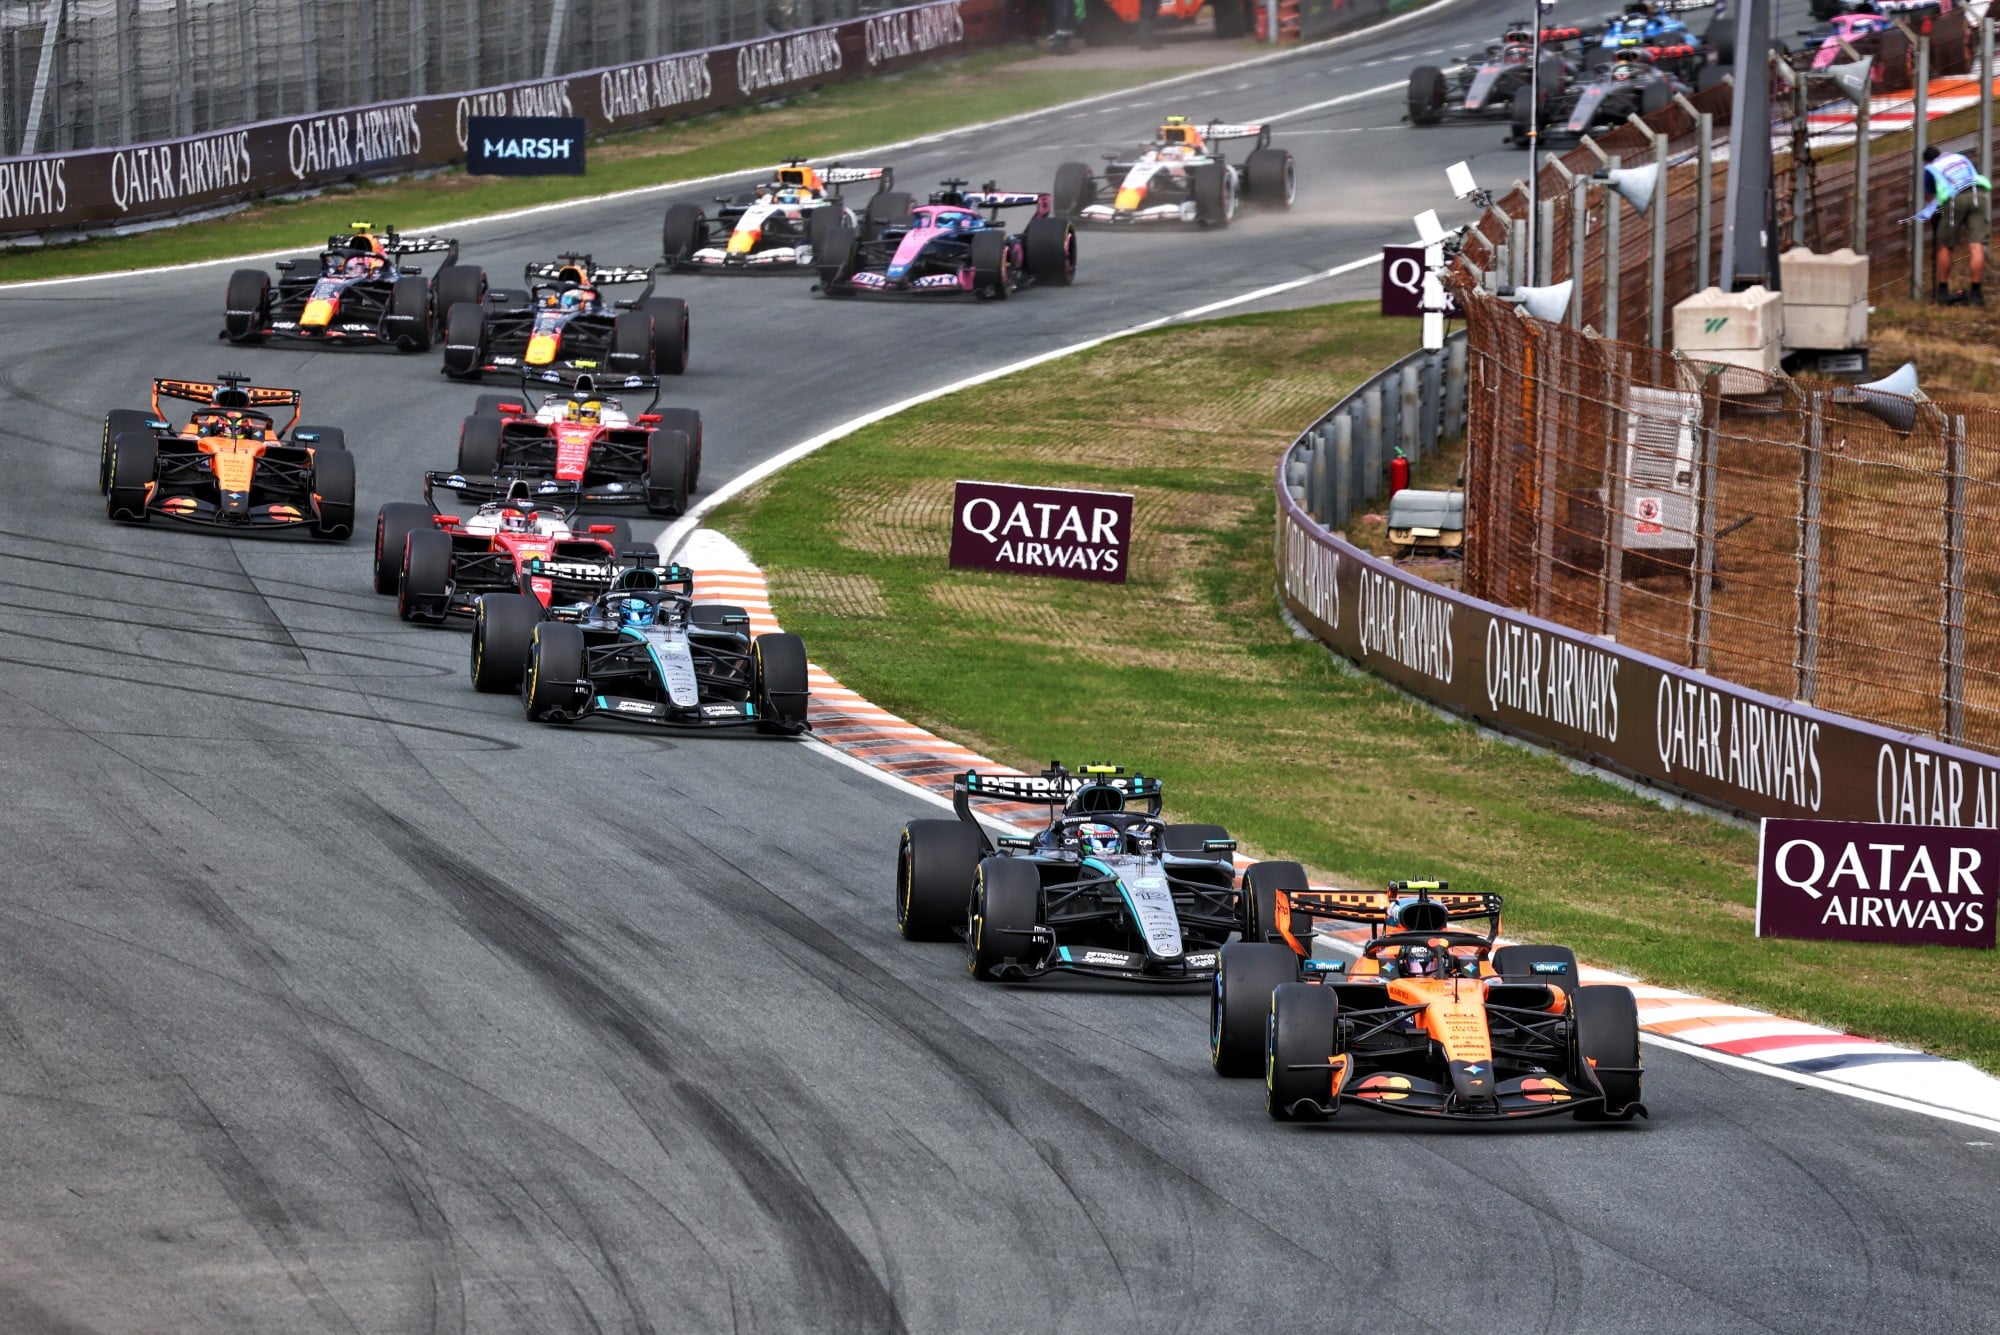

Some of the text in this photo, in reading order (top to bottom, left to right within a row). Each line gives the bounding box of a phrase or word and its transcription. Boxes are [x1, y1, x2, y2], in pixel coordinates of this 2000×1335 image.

[600, 52, 711, 122] QATAR AIRWAYS
[737, 27, 842, 95] QATAR AIRWAYS
[112, 130, 250, 212] QATAR AIRWAYS
[288, 103, 421, 180] QATAR AIRWAYS
[483, 137, 571, 159] MARSH
[962, 497, 1120, 546] QATAR
[544, 562, 666, 582] PETROS
[995, 539, 1119, 573] AIRWAYS
[1358, 567, 1454, 684] QATAR AIRWAYS
[1486, 617, 1619, 743] QATAR AIRWAYS
[1656, 673, 1822, 812] QATAR AIRWAYS
[981, 776, 1128, 798] PETRONS
[1876, 743, 1964, 827] QATAR
[1774, 839, 1985, 899] QATAR
[1821, 895, 1985, 932] AIRWAYS
[1086, 951, 1130, 961] PETRONAS
[1315, 961, 1341, 971] allwyn
